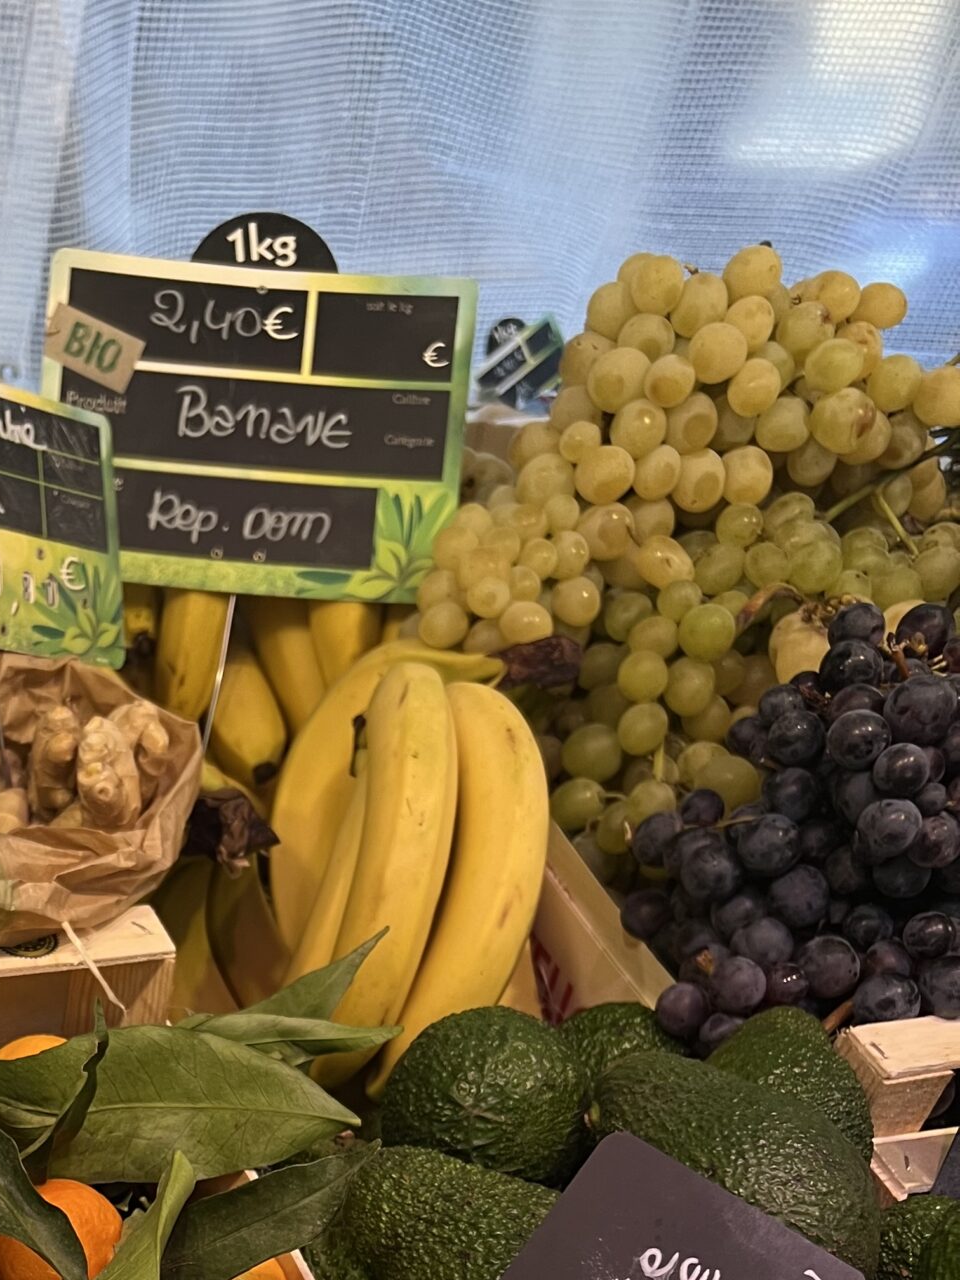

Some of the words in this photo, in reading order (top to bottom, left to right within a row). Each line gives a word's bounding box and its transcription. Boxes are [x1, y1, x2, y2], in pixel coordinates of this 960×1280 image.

[226, 222, 298, 267] 1kg
[64, 320, 123, 374] BIO
[422, 341, 451, 369] €
